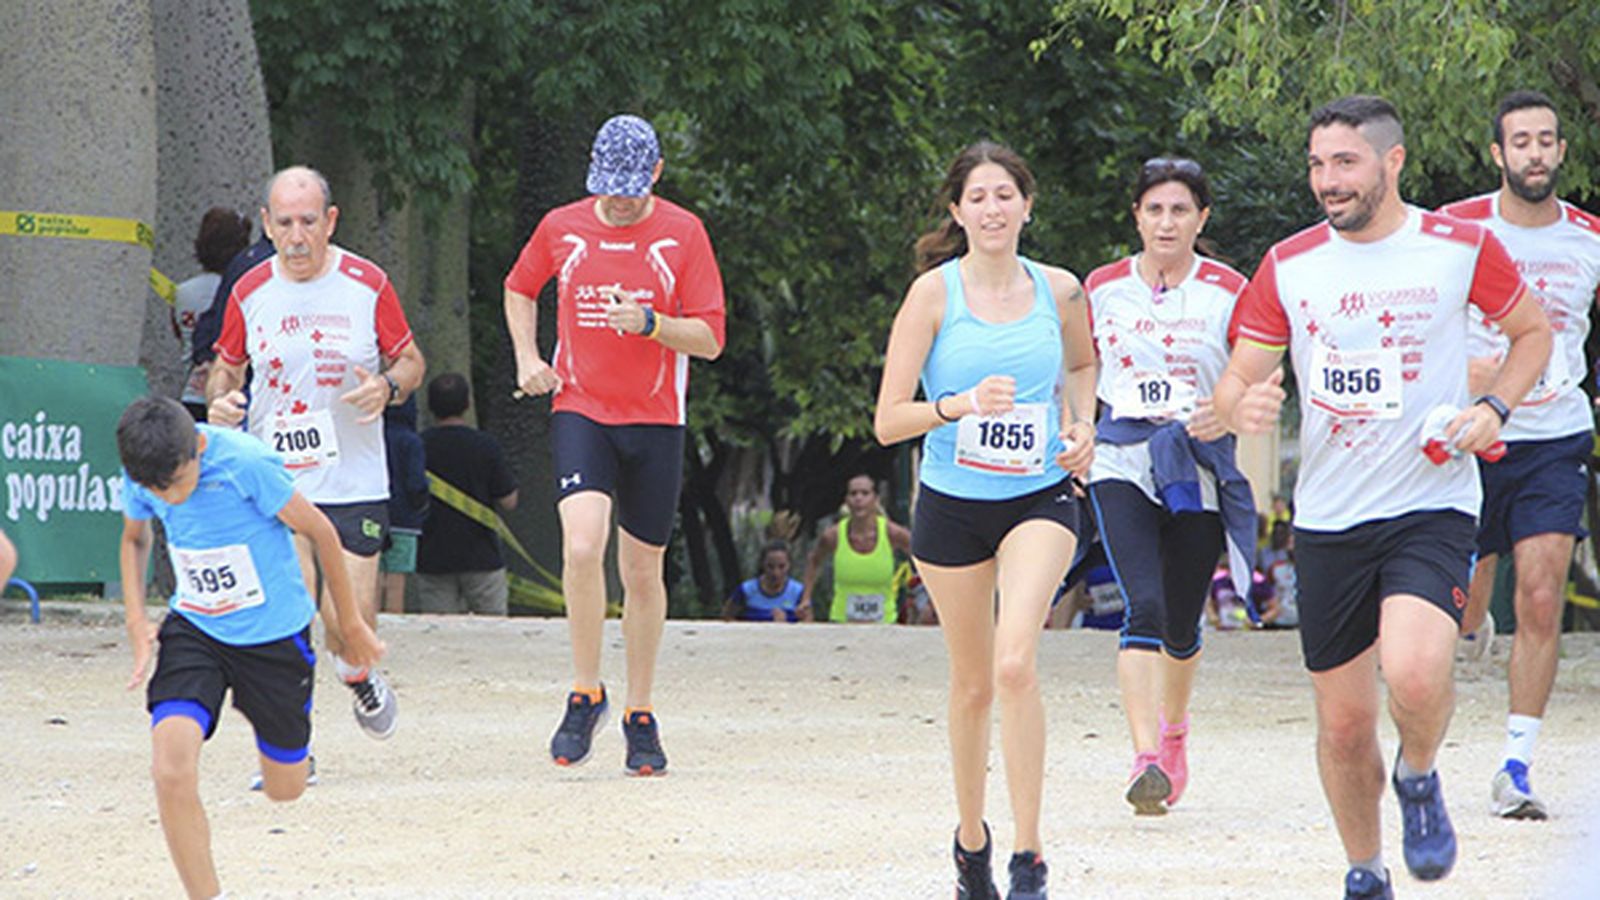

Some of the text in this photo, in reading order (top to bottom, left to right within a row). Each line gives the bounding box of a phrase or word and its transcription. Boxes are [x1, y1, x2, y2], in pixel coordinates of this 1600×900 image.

[1323, 367, 1381, 394] 1856
[3, 410, 82, 461] caixa
[274, 427, 321, 452] 2100
[979, 421, 1035, 451] 1855
[6, 462, 124, 522] popular
